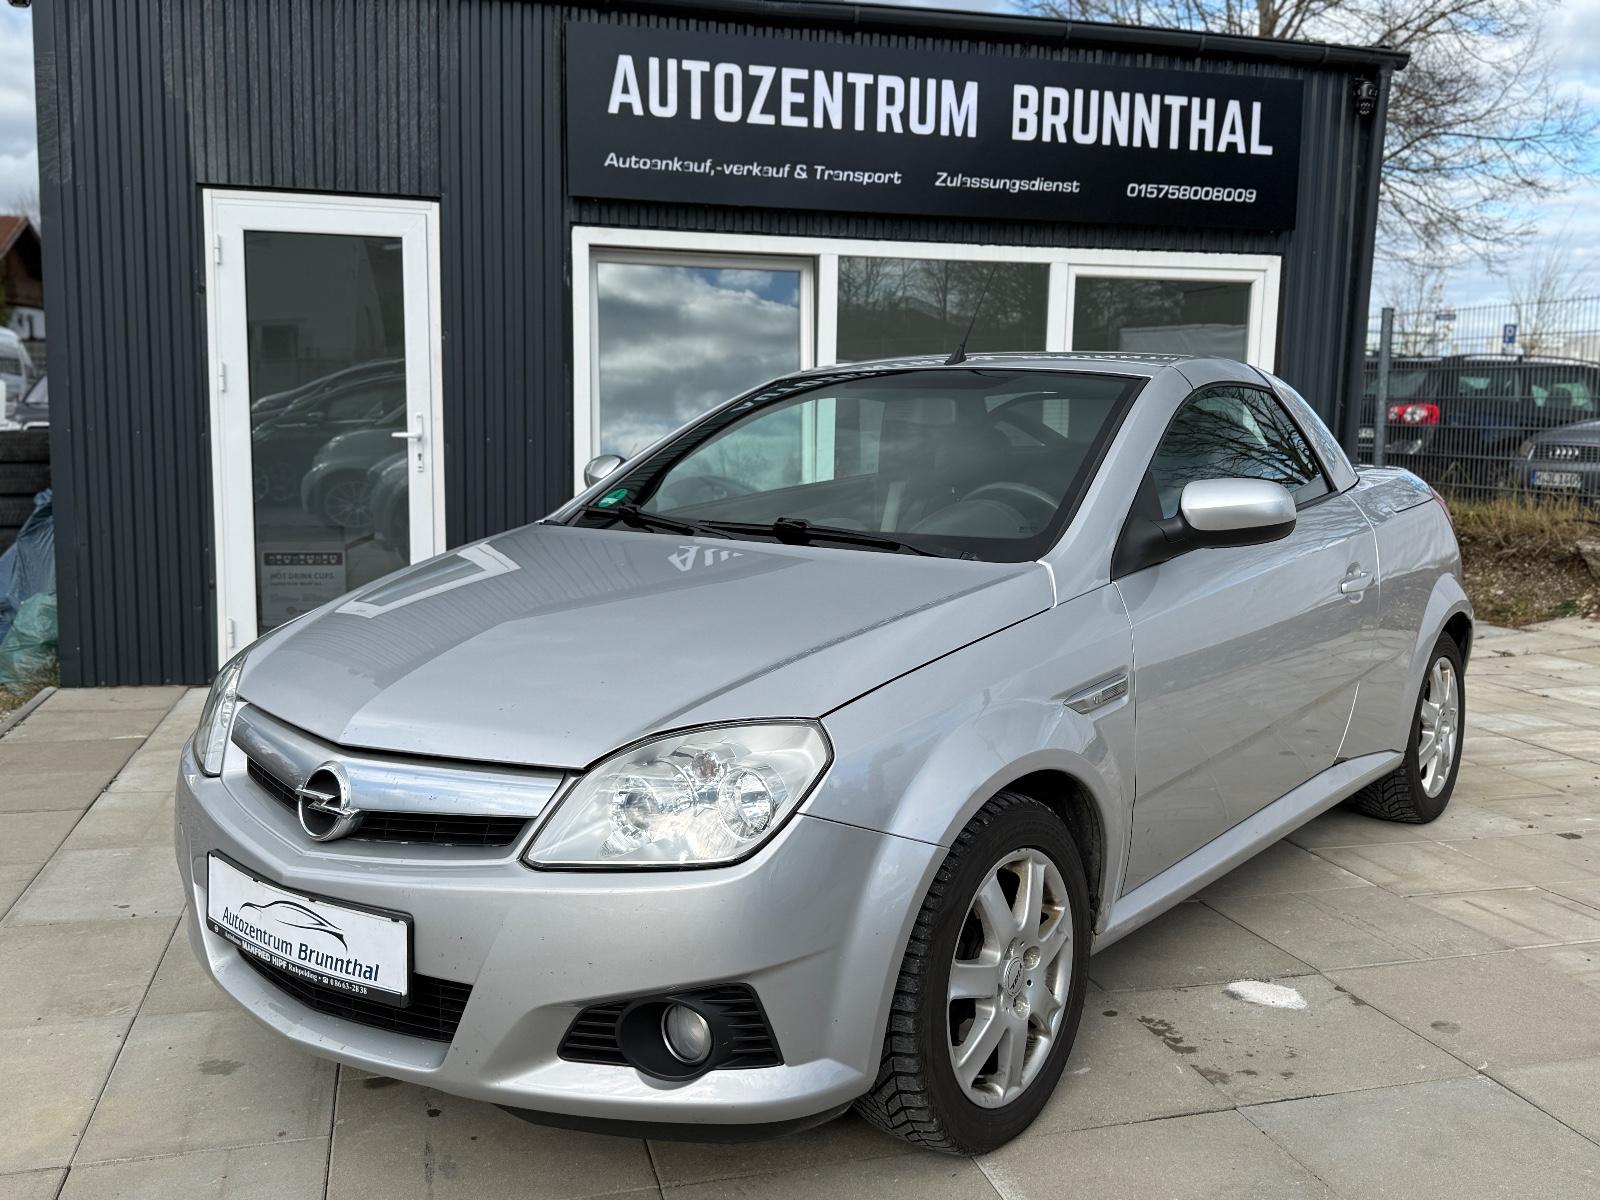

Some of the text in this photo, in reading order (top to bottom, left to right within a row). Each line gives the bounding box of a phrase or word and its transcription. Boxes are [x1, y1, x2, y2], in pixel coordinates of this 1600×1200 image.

[607, 54, 1274, 156] AUTOZENTRUM BRUNNTHAL
[604, 152, 902, 186] Autoankauf,-verkauf & Transport
[934, 171, 1081, 193] Zulassungsdienst
[1126, 182, 1257, 204] 015758008009
[222, 906, 380, 982] Autozentrum Brunnthal
